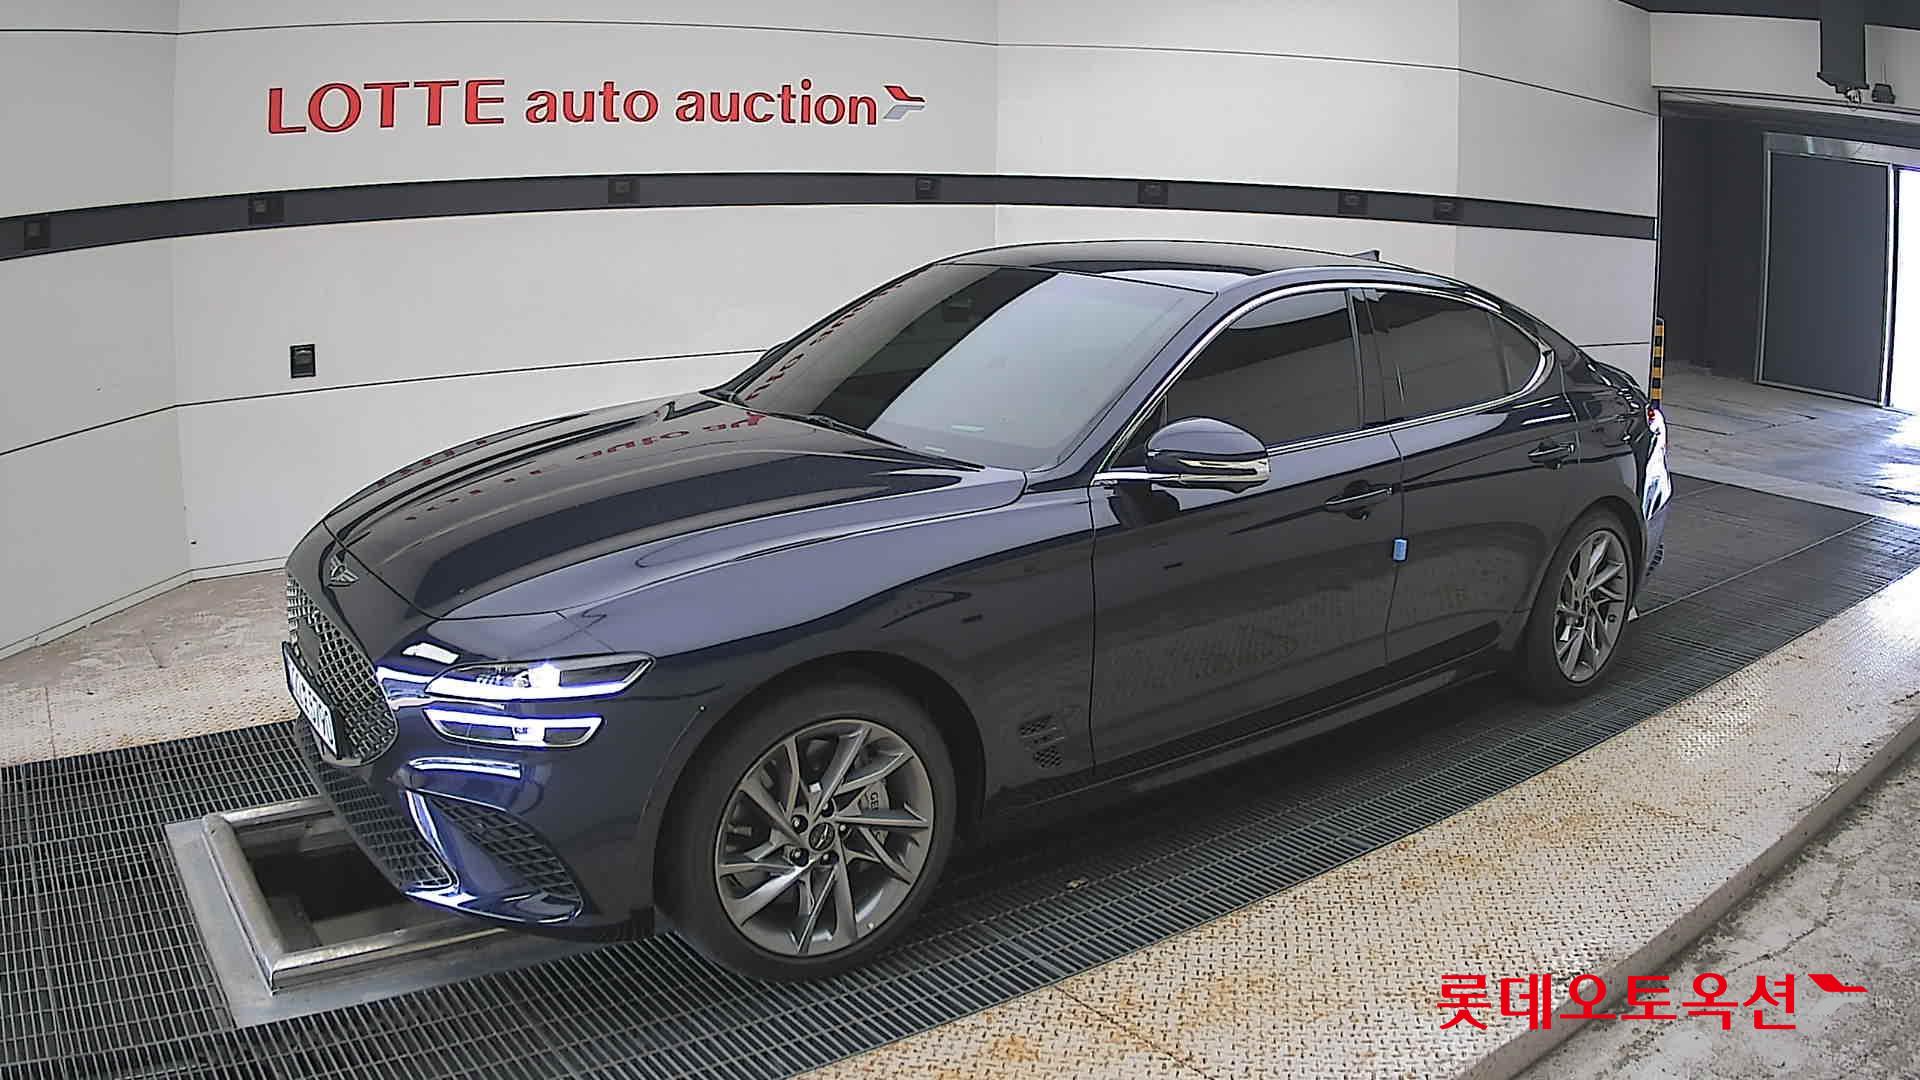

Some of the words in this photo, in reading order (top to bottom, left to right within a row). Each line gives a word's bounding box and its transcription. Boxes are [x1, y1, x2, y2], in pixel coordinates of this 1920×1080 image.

[268, 79, 505, 135] LOTTE
[526, 82, 659, 124] auto
[676, 79, 878, 126] auction
